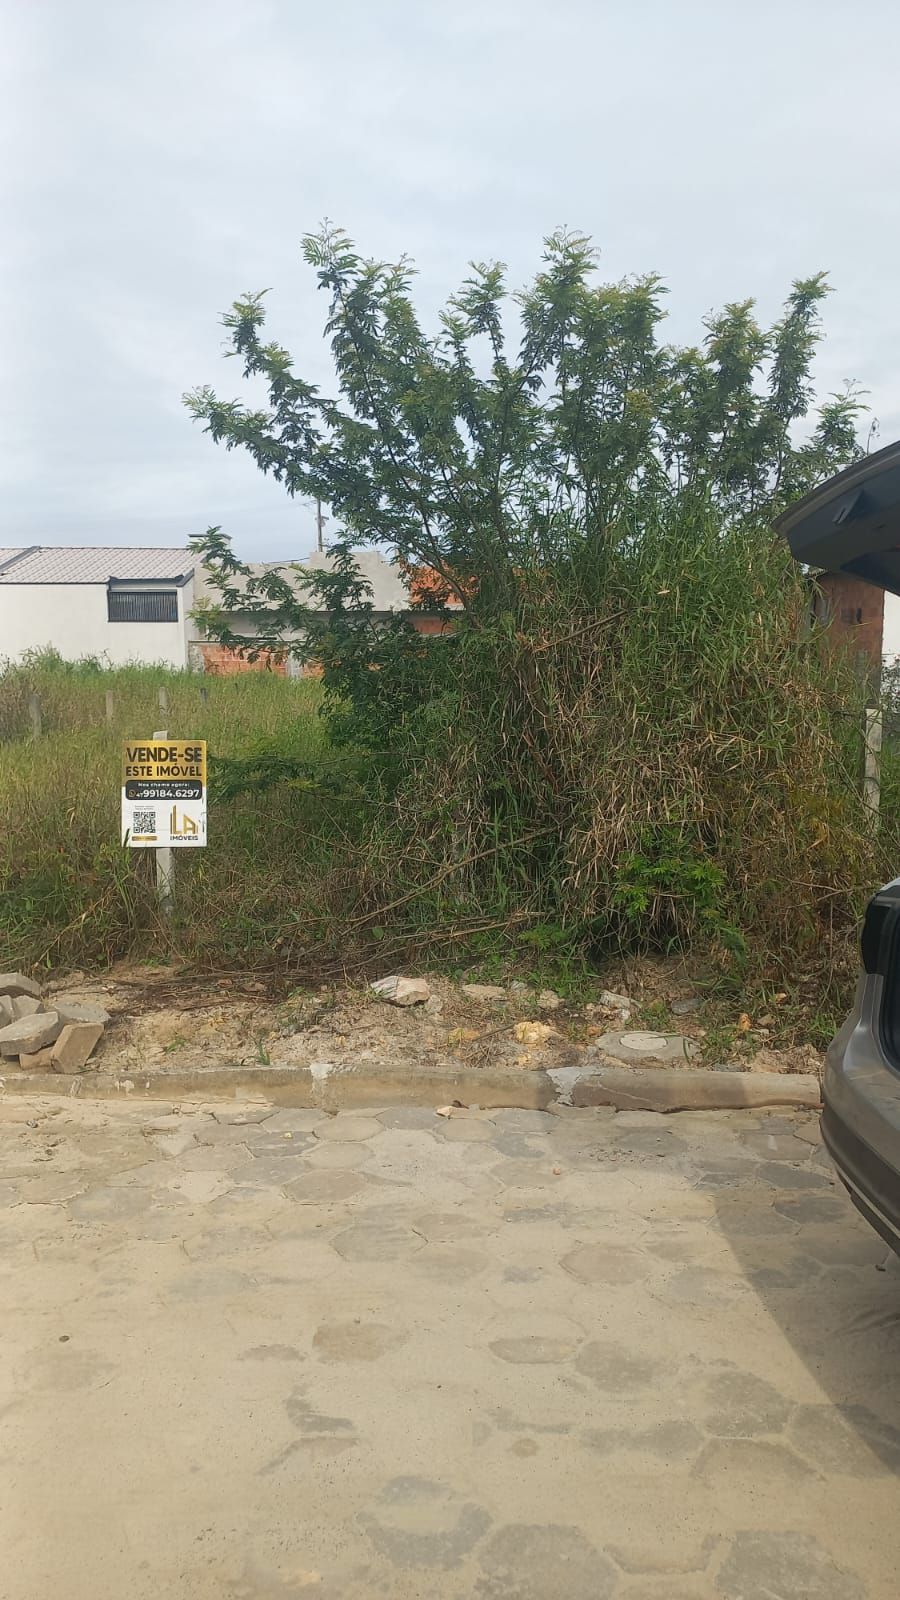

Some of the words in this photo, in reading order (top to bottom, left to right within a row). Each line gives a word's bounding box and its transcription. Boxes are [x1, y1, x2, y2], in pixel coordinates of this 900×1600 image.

[126, 747, 202, 762] VENDE-SE
[126, 766, 152, 776] ESTE
[157, 763, 202, 776] IMÓVEL
